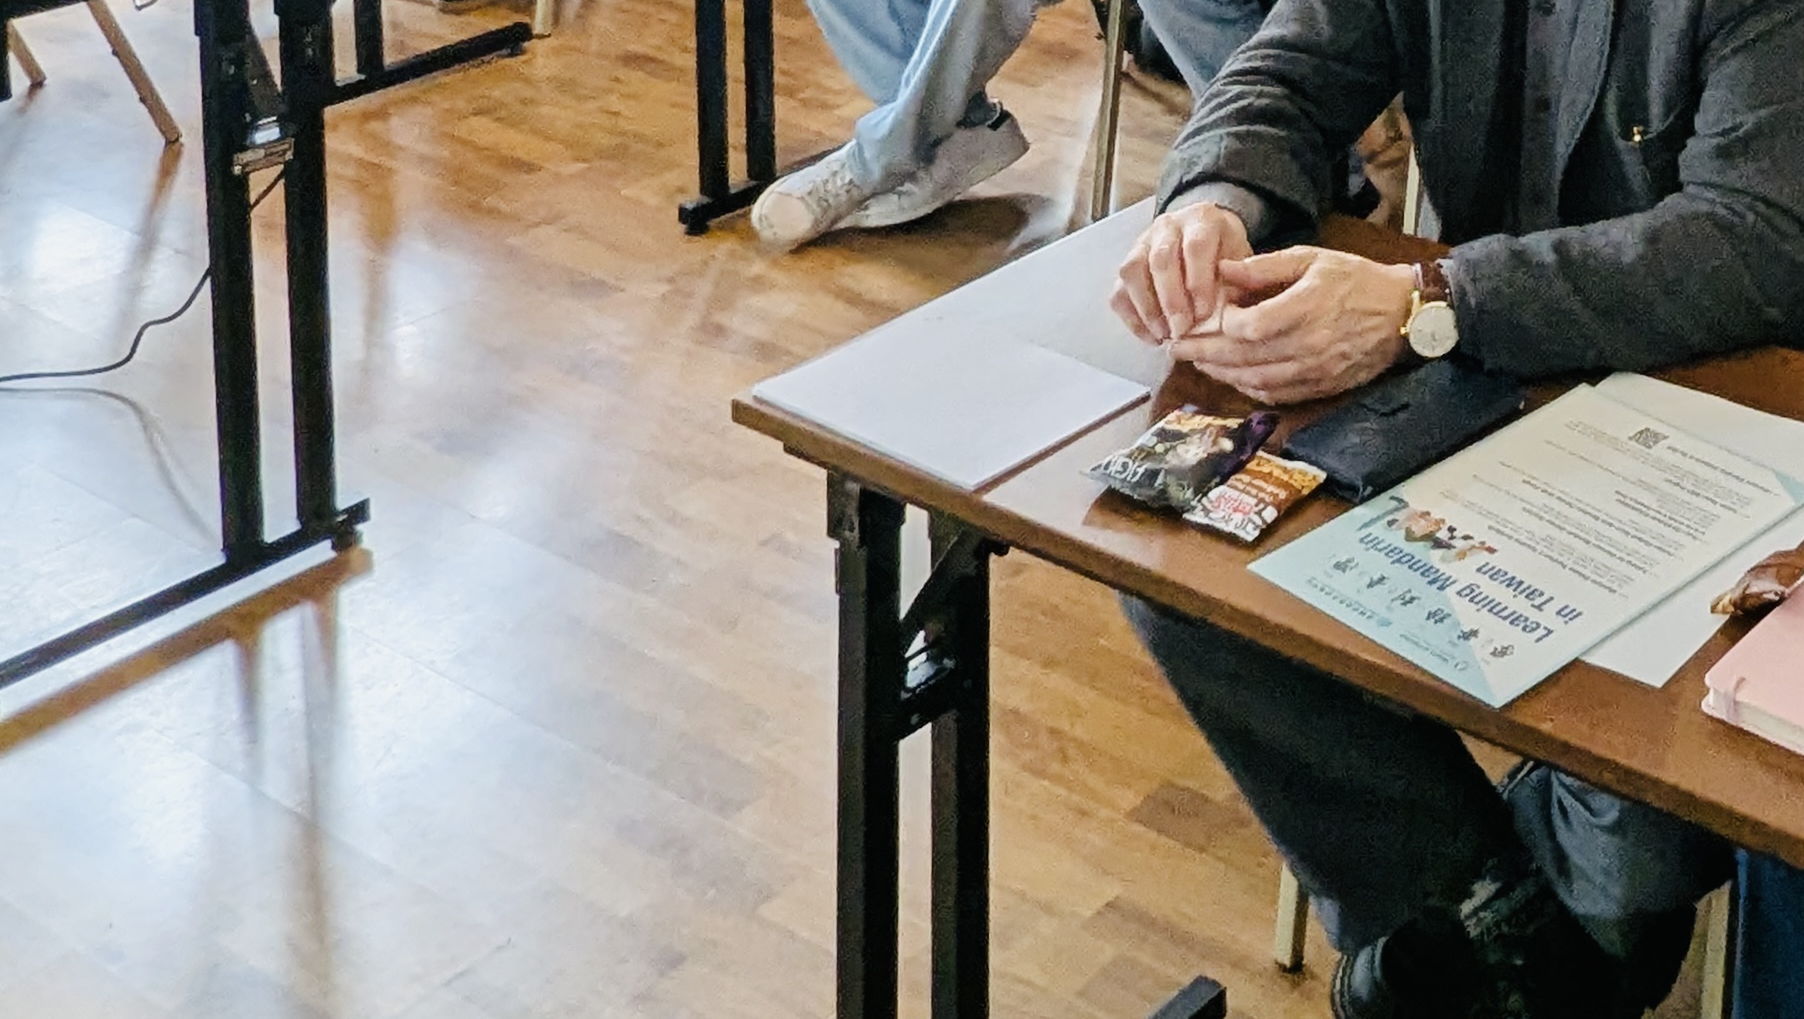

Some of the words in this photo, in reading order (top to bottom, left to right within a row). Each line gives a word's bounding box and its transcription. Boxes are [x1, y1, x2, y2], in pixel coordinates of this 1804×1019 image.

[1358, 532, 1457, 592] Mandarin
[1475, 561, 1556, 612] Taiwan
[1456, 582, 1554, 643] Learning
[1556, 603, 1583, 625] in
